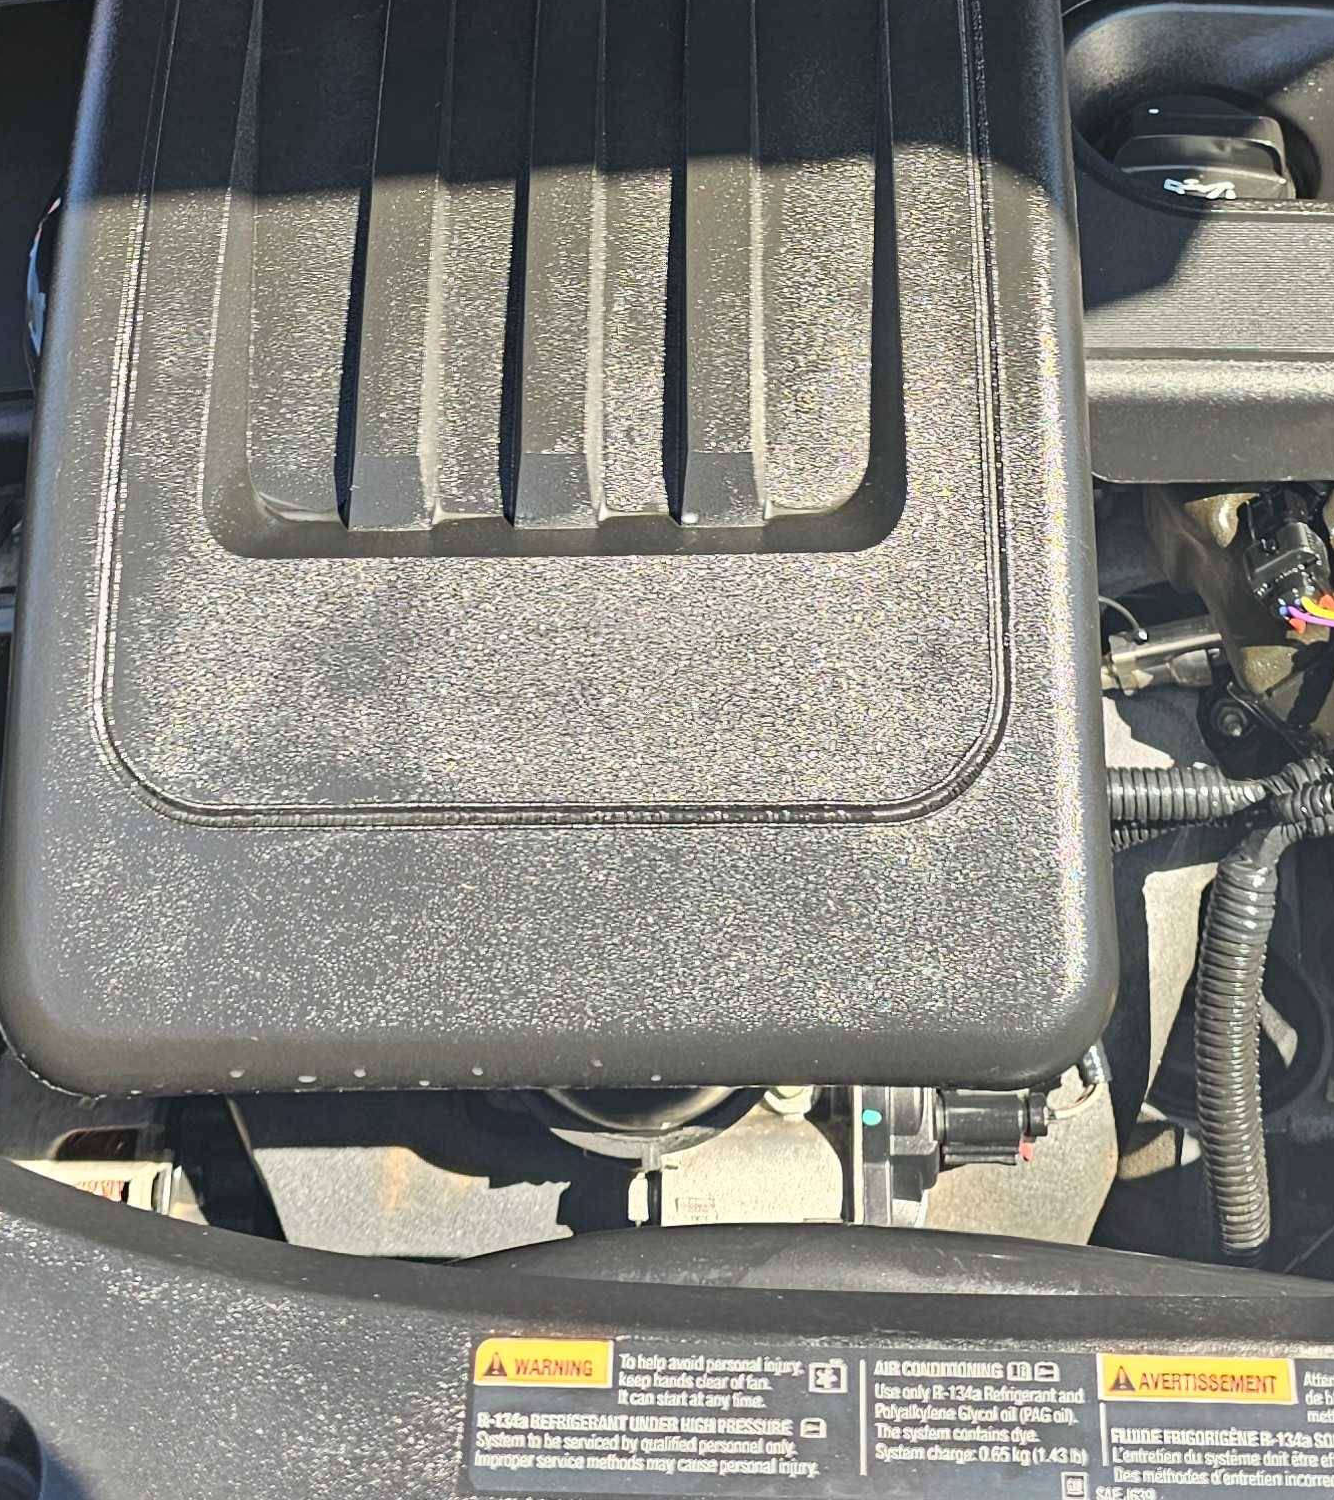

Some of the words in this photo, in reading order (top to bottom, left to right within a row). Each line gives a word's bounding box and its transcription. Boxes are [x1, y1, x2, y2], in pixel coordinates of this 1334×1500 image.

[514, 1358, 593, 1377] WARNING
[618, 1353, 637, 1371] To
[637, 1353, 667, 1372] help
[667, 1355, 705, 1371] avoid
[705, 1357, 763, 1374] personal
[873, 1360, 901, 1377] AIR
[901, 1361, 1004, 1379] CONDITIONING
[618, 1371, 652, 1390] keep
[653, 1372, 695, 1389] hands
[695, 1373, 729, 1390] clear
[730, 1373, 746, 1390] of
[1138, 1372, 1277, 1394] AVERTISSEMENT
[617, 1389, 629, 1405] It
[629, 1392, 655, 1406] can
[656, 1390, 688, 1407] start
[688, 1391, 705, 1407] at
[705, 1394, 731, 1410] any
[874, 1382, 901, 1400] Use
[902, 1383, 931, 1403] only
[932, 1384, 983, 1402] R-134a
[983, 1385, 1057, 1406] Refrigerant
[1057, 1387, 1085, 1404] and
[1305, 1389, 1324, 1406] de
[529, 1412, 628, 1431] REFRIGERANT
[628, 1416, 679, 1433] UNDER
[680, 1416, 717, 1434] HIGH
[717, 1417, 794, 1436] PRESSURE
[874, 1402, 958, 1423] Polyalkylene
[957, 1404, 999, 1425] Glycol
[999, 1405, 1017, 1422] oil
[1019, 1406, 1053, 1425] (PAG
[476, 1430, 526, 1450] System
[527, 1432, 542, 1449] to
[543, 1432, 563, 1450] be
[563, 1433, 620, 1450] serviced
[621, 1434, 639, 1453] by
[640, 1435, 698, 1454] qualified
[698, 1437, 764, 1456] personnel
[874, 1422, 902, 1439] The
[902, 1424, 952, 1443] system
[952, 1425, 1010, 1442] contains
[1110, 1427, 1164, 1444] FLUIDE
[1260, 1431, 1314, 1449] R-134a
[474, 1449, 535, 1470] Improper
[535, 1451, 585, 1469] service
[586, 1453, 646, 1471] methods
[646, 1457, 677, 1475] may
[677, 1458, 718, 1473] cause
[718, 1457, 778, 1476] personal
[875, 1442, 926, 1462] System
[1012, 1446, 1031, 1467] kg
[1183, 1448, 1204, 1465] du
[1262, 1450, 1290, 1467] doit
[1291, 1450, 1319, 1468] être
[1114, 1466, 1142, 1483] Des
[1142, 1466, 1210, 1485] méthodes
[1095, 1485, 1124, 1500] SAE
